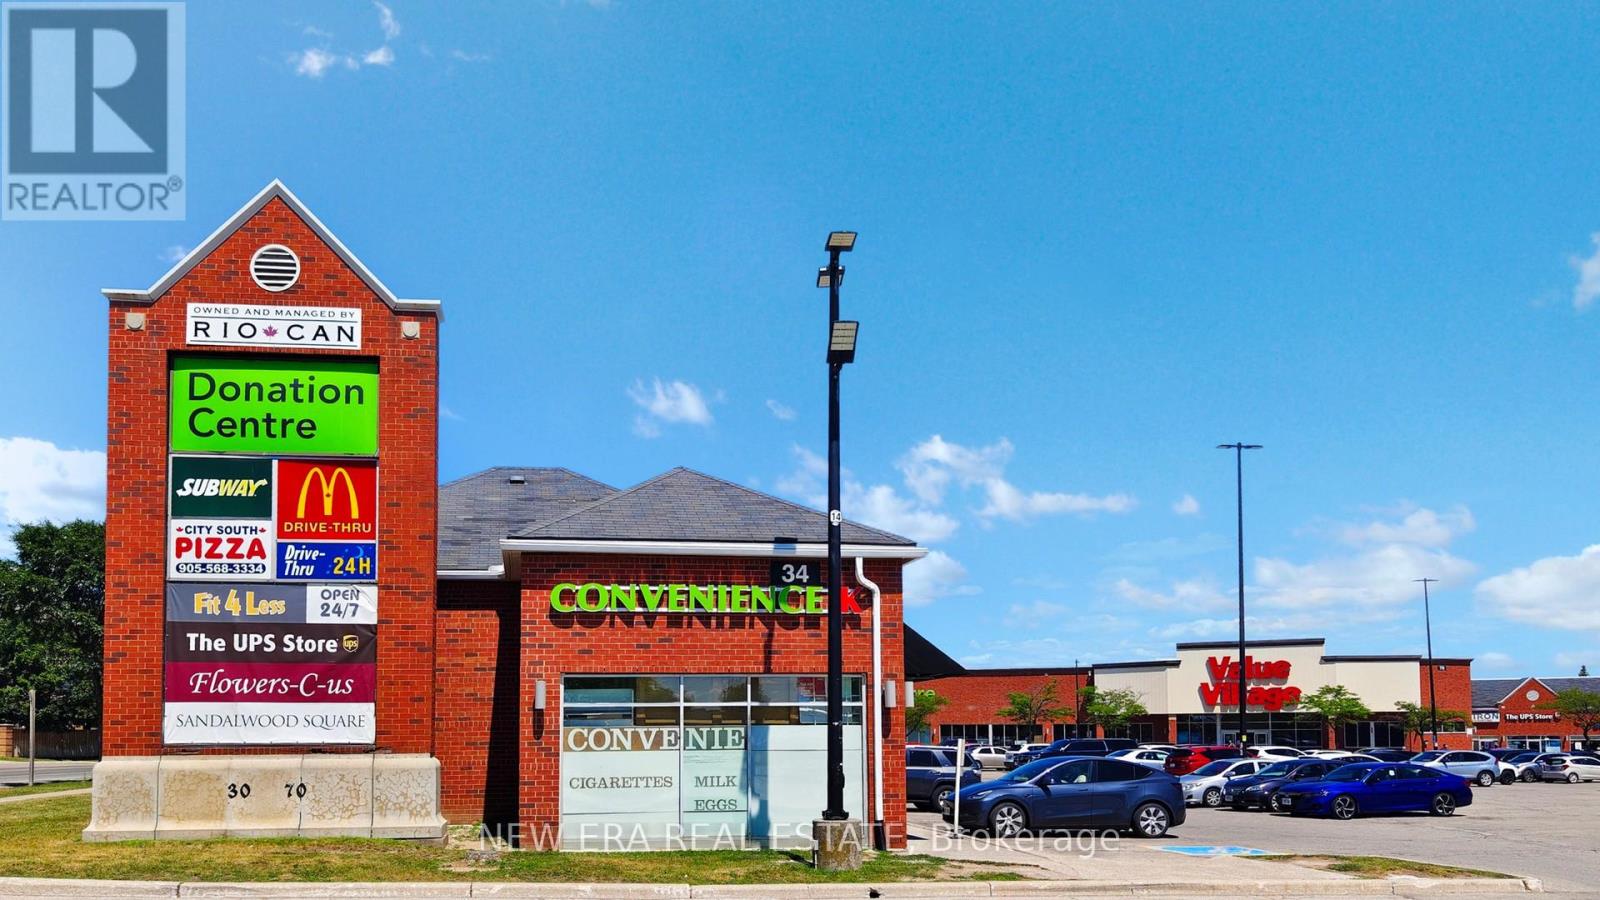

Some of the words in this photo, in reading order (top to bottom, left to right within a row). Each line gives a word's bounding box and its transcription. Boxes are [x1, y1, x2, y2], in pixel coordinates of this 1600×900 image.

[194, 306, 239, 315] OWNED
[245, 308, 270, 317] AND
[275, 309, 335, 318] MANAGED
[341, 311, 355, 319] BY
[193, 321, 257, 339] RIO
[287, 324, 354, 342] CAN
[188, 372, 364, 405] Donation
[188, 407, 317, 439] Centre
[176, 478, 268, 497] SUBWAY
[831, 511, 841, 520] 14
[185, 525, 212, 534] CITY
[217, 526, 258, 535] SOUTH
[284, 521, 372, 533] DRIVE-THRU
[175, 537, 266, 560] PIZZA
[284, 545, 326, 561] Drive-
[179, 564, 263, 574] 905-568-3334
[284, 560, 314, 576] Thru
[781, 564, 809, 583] 34
[193, 592, 221, 616] Fit
[225, 589, 242, 616] 4
[246, 591, 286, 616] Less
[320, 589, 360, 600] OPEN
[550, 583, 824, 614] CONVENIENCE
[320, 602, 359, 619] 24/7
[186, 633, 226, 651] The
[233, 634, 276, 652] UPS
[283, 634, 338, 653] Store
[343, 638, 358, 650] ups
[189, 668, 354, 697] Flowers-C-us
[176, 714, 298, 728] SANDALWOOD
[303, 714, 366, 730] SQUARE
[569, 776, 673, 789] CIGARETTES
[694, 775, 737, 788] MILK
[227, 783, 251, 799] 30
[284, 782, 307, 798] 70
[694, 799, 738, 811] EGGS
